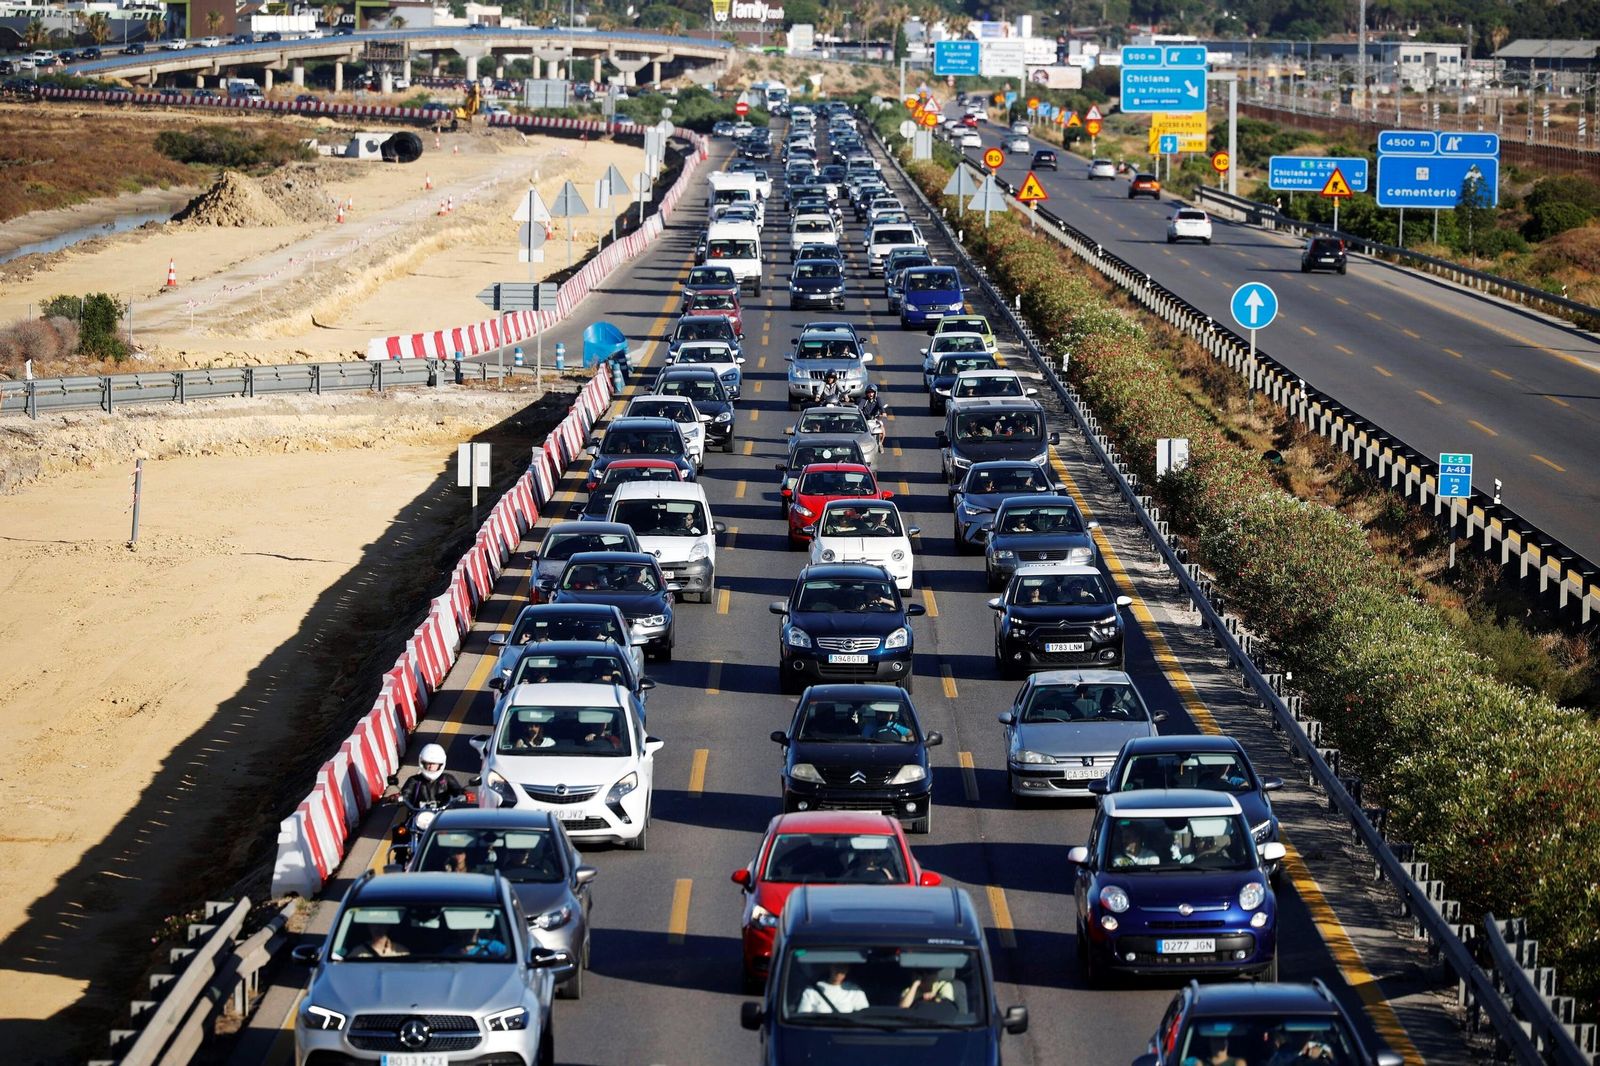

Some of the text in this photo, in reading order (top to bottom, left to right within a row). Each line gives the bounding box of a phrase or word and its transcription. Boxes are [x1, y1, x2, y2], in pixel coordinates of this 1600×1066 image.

[1127, 74, 1170, 83] Chiclana
[1386, 139, 1415, 147] 4500
[1485, 140, 1491, 148] 7
[1273, 169, 1308, 177] Chiclana
[1273, 177, 1312, 185] Algeciras
[1387, 187, 1457, 197] cementerio
[1451, 485, 1459, 494] 2
[1079, 770, 1099, 778] 3518
[1164, 941, 1212, 951] 0277 JGN
